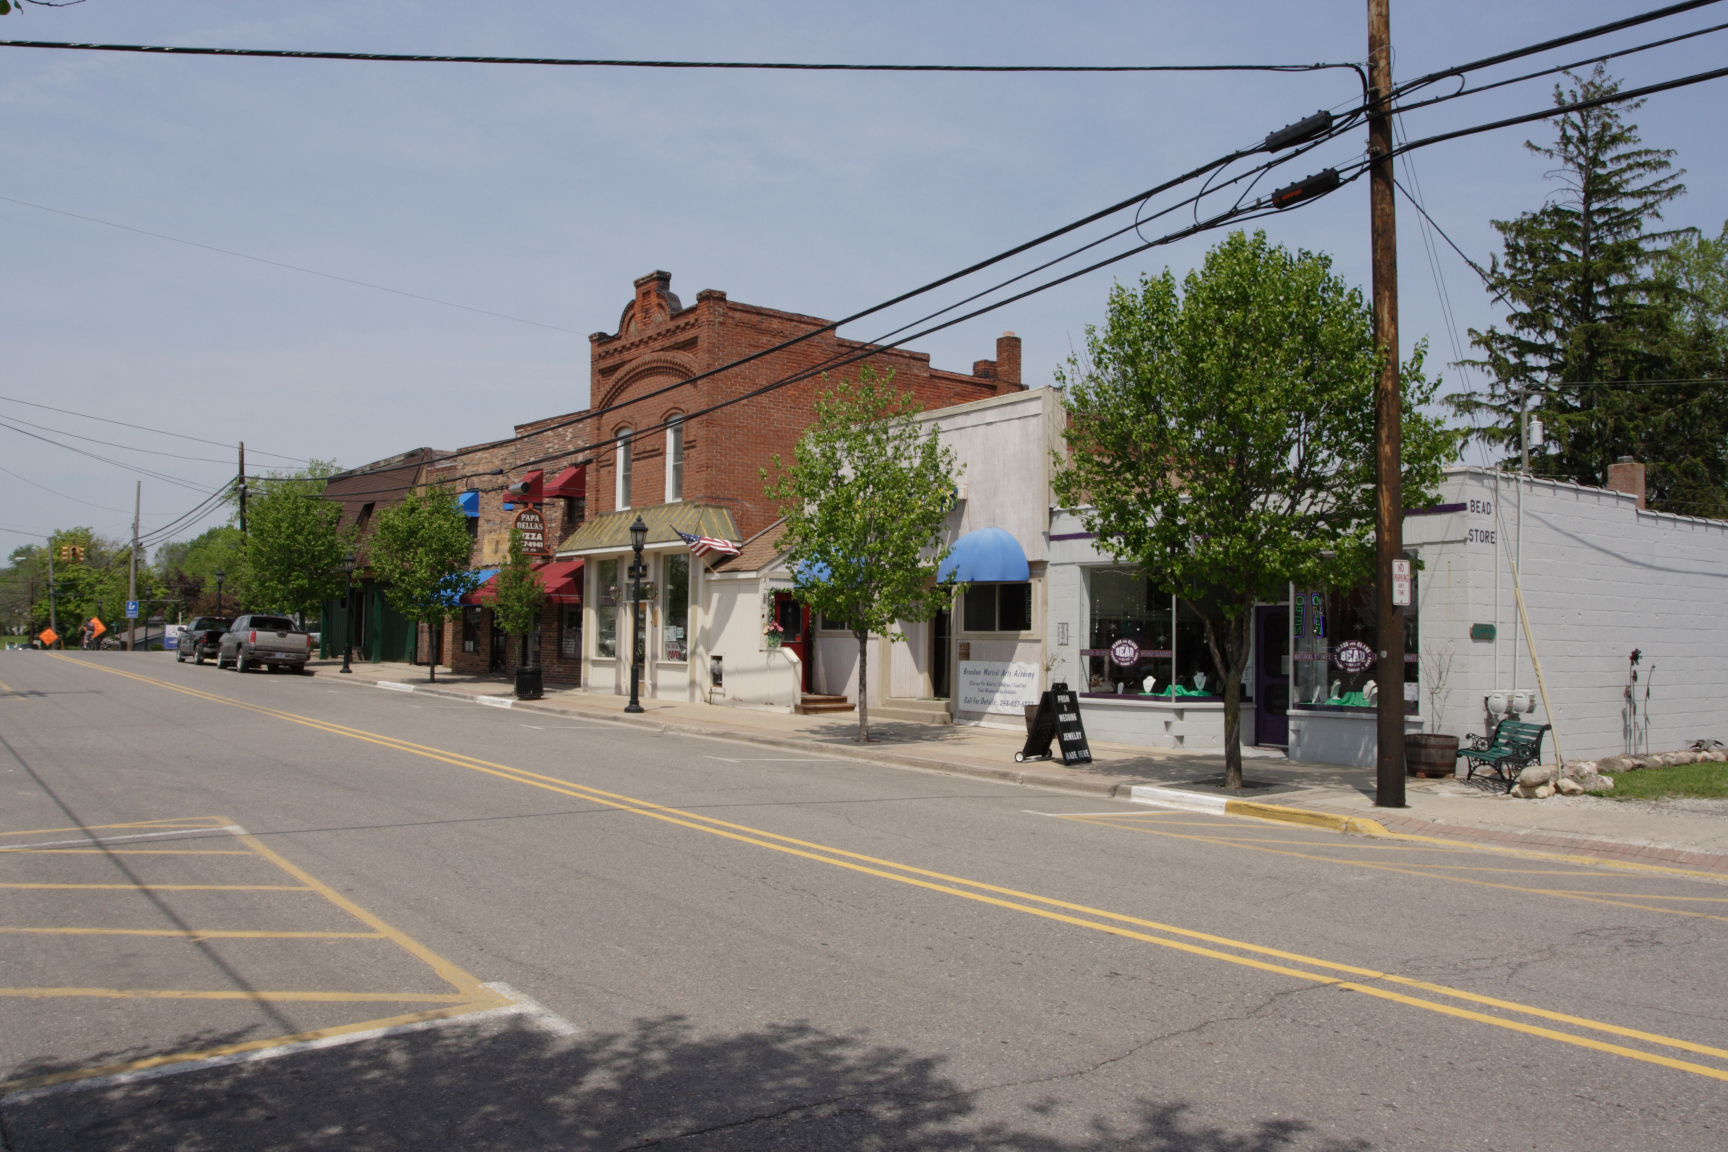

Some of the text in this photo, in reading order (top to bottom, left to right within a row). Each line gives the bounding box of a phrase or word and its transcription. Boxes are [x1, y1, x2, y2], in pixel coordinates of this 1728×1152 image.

[1470, 499, 1491, 515] BEAD
[521, 514, 540, 522] PAPA
[1468, 529, 1495, 544] STORE
[1115, 646, 1134, 657] BEAD
[1340, 650, 1365, 662] BEAD
[983, 668, 1000, 677] Martial
[1014, 669, 1035, 680] Academy
[1063, 731, 1082, 741] JEWELRY
[1065, 751, 1078, 760] MADE
